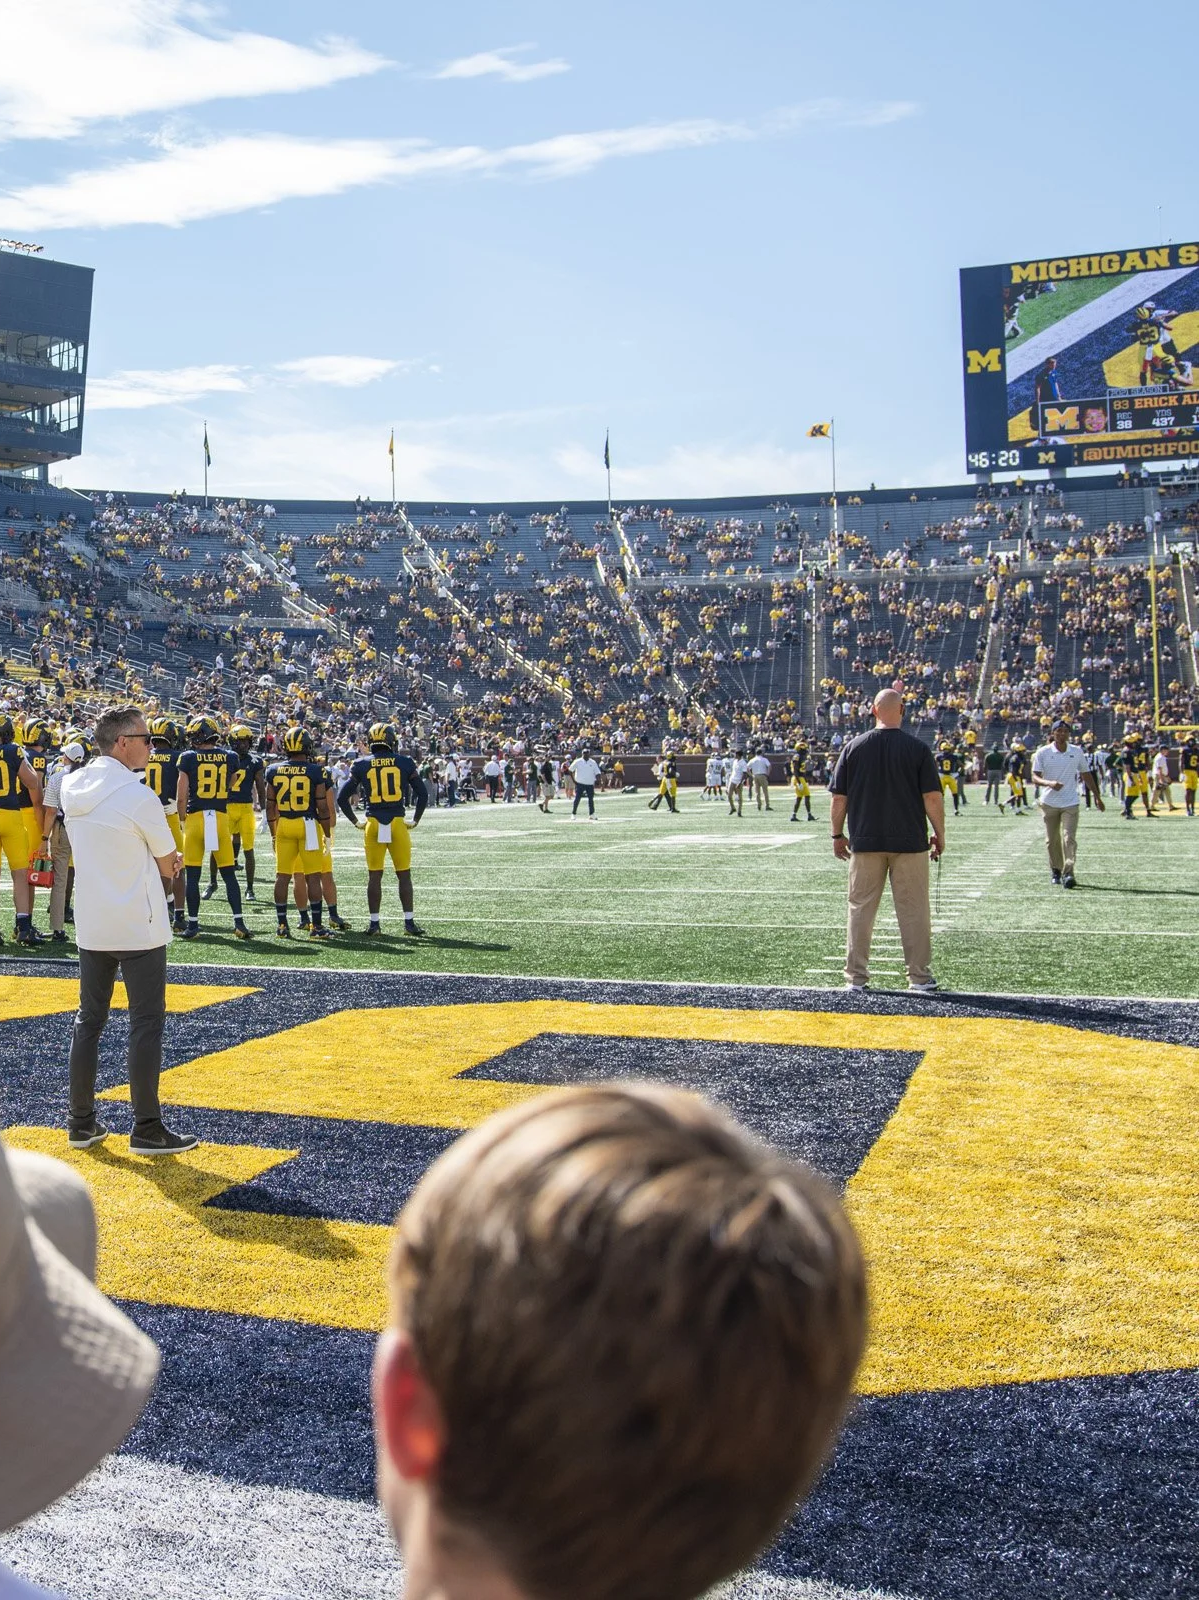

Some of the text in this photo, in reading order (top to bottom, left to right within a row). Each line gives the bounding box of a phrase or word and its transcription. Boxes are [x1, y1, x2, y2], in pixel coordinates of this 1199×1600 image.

[1010, 248, 1170, 284] MICHIGAN
[967, 348, 1001, 373] M
[1113, 399, 1129, 410] 83
[1134, 395, 1179, 409] ERICK
[1045, 406, 1080, 432] M
[1116, 412, 1133, 420] REC
[1116, 420, 1133, 430] 38
[1151, 416, 1175, 427] 437
[968, 449, 1020, 468] 46:20
[1038, 451, 1056, 464] M
[33, 757, 46, 769] 88
[148, 754, 171, 762] EMONS
[196, 753, 228, 762] O'LEARY
[371, 758, 396, 767] BERRY
[277, 766, 306, 775] NICHOLS
[145, 762, 162, 797] 0
[196, 763, 228, 799] 81
[366, 766, 402, 804] 10
[273, 776, 310, 811] 28
[30, 872, 39, 882] G
